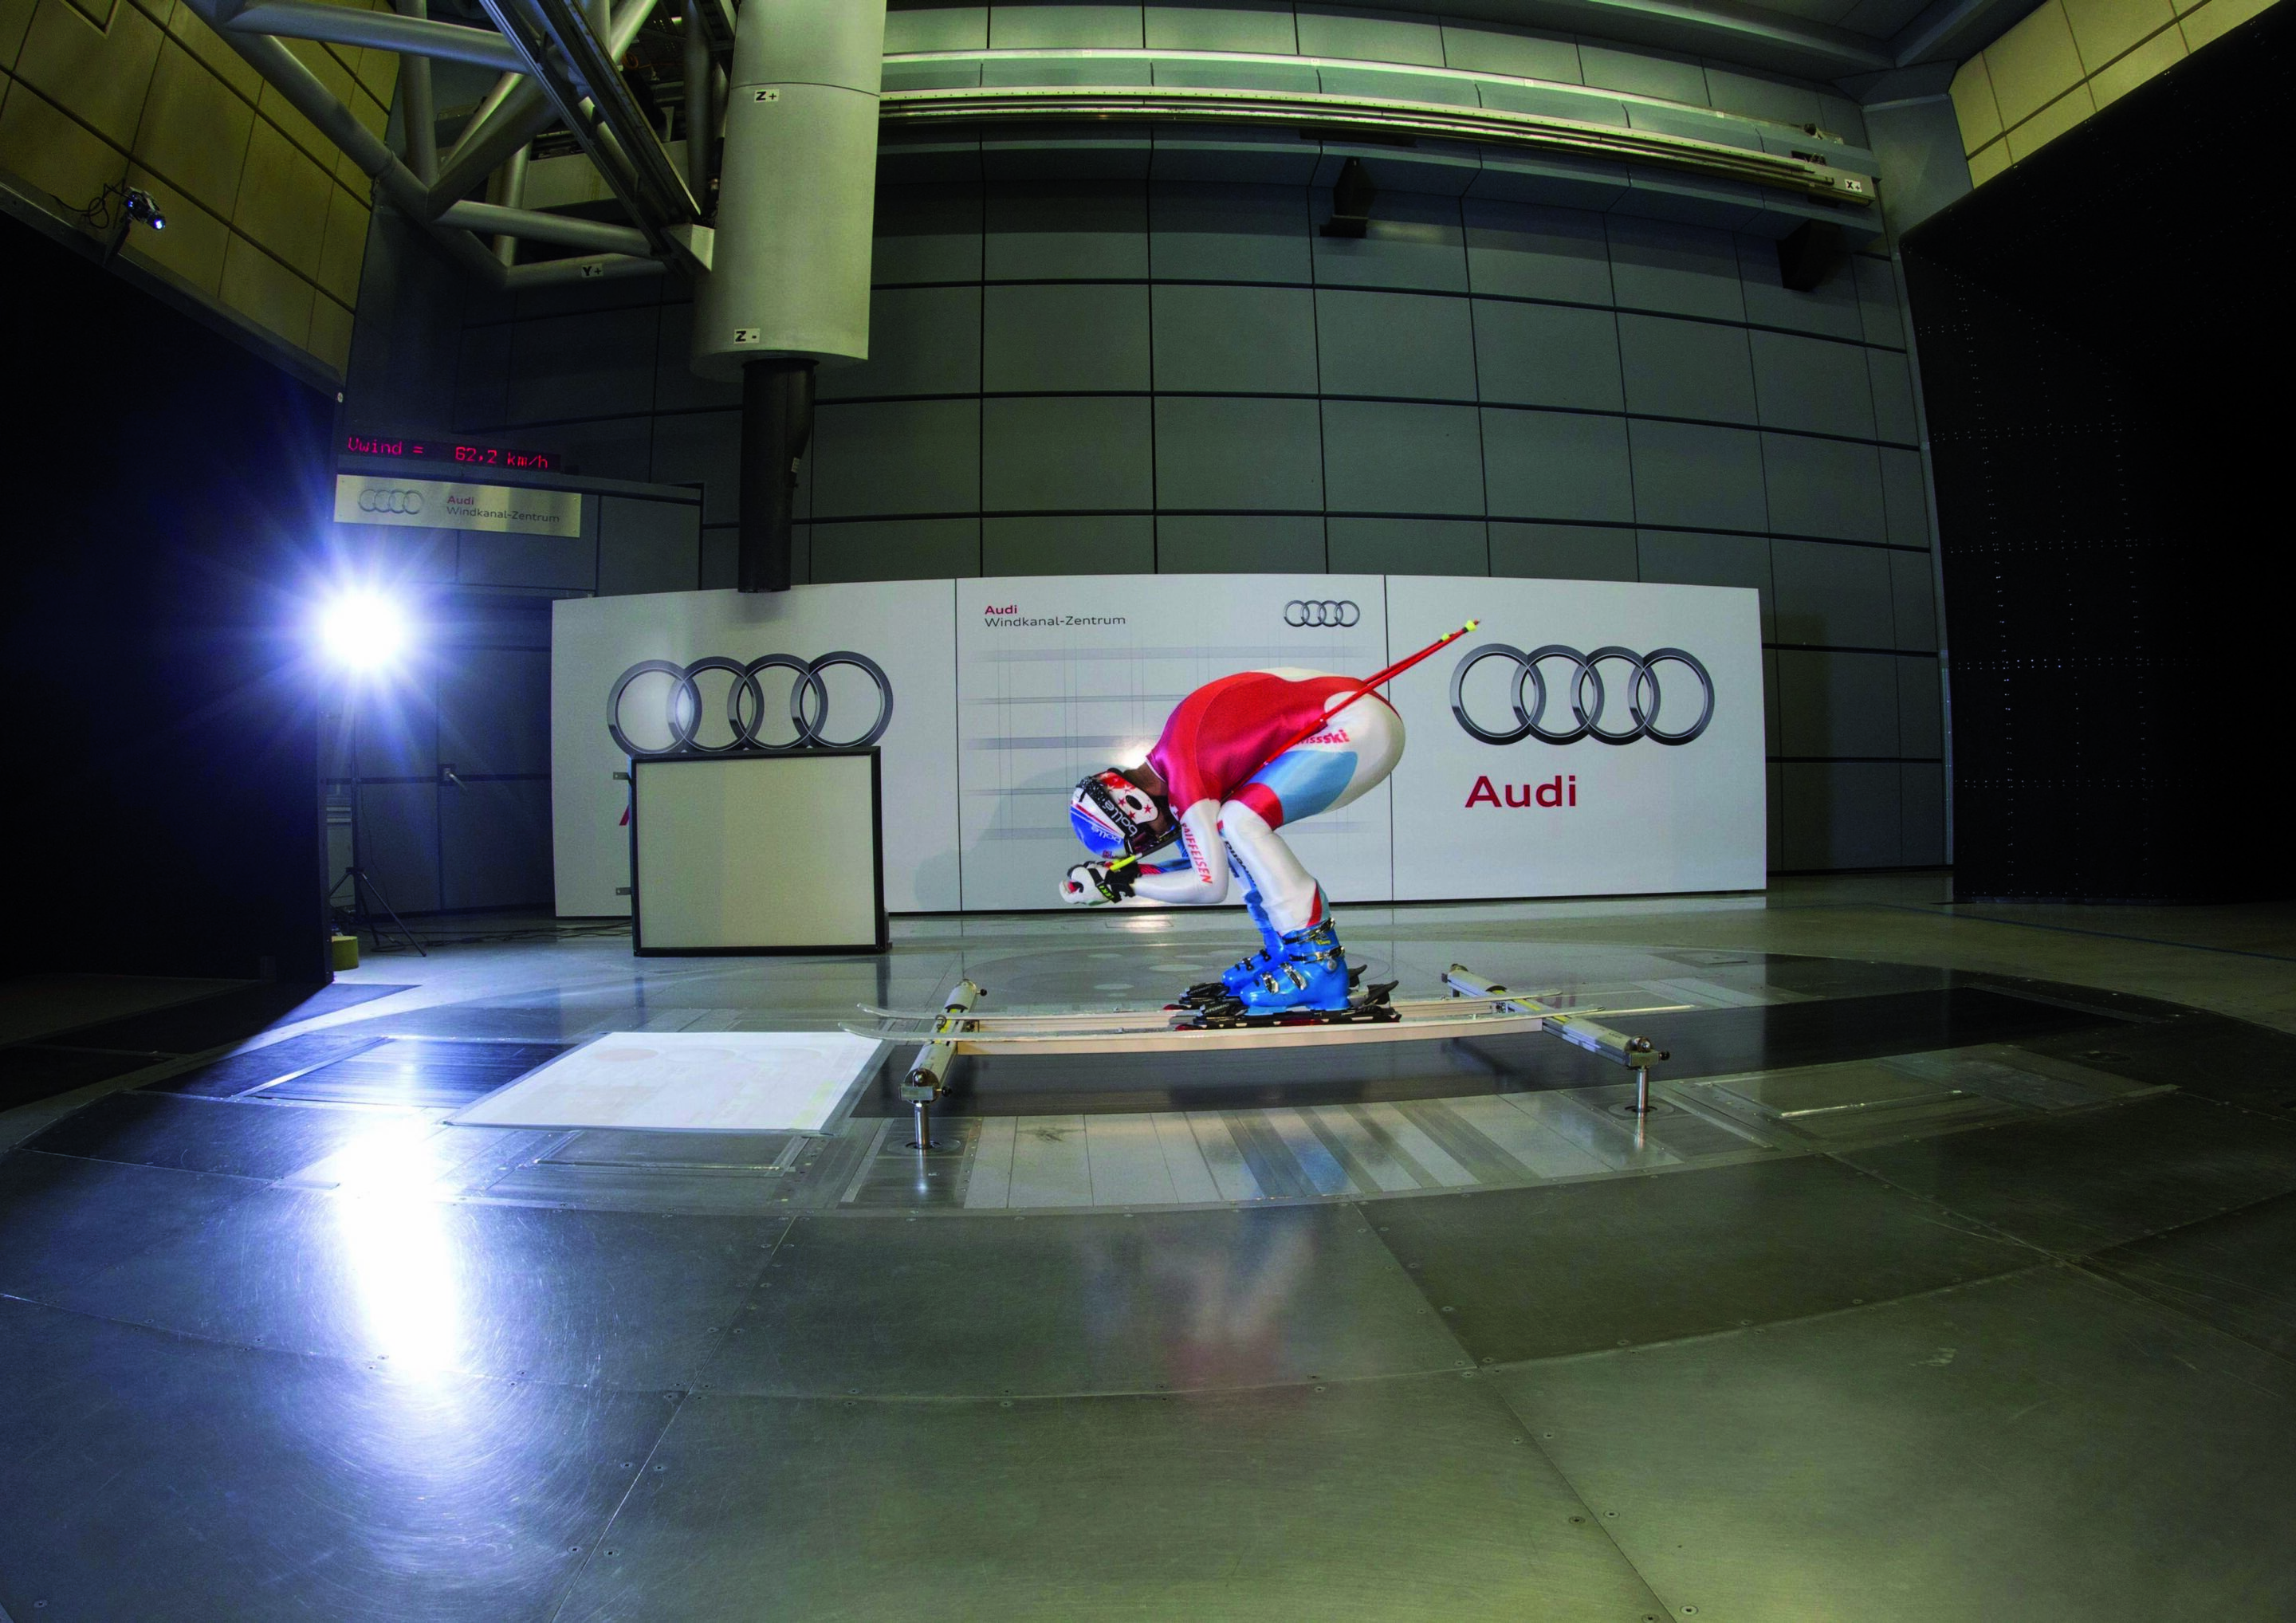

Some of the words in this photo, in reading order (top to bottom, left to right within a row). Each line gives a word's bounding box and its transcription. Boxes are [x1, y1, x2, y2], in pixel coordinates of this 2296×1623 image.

[507, 451, 548, 469] km/h
[446, 495, 474, 505] Audi
[446, 506, 560, 523] Windkanal-Zentrum
[985, 604, 1018, 615] Audi
[985, 615, 1126, 627] Windkanal-Zentrum
[1464, 775, 1577, 808] Audi
